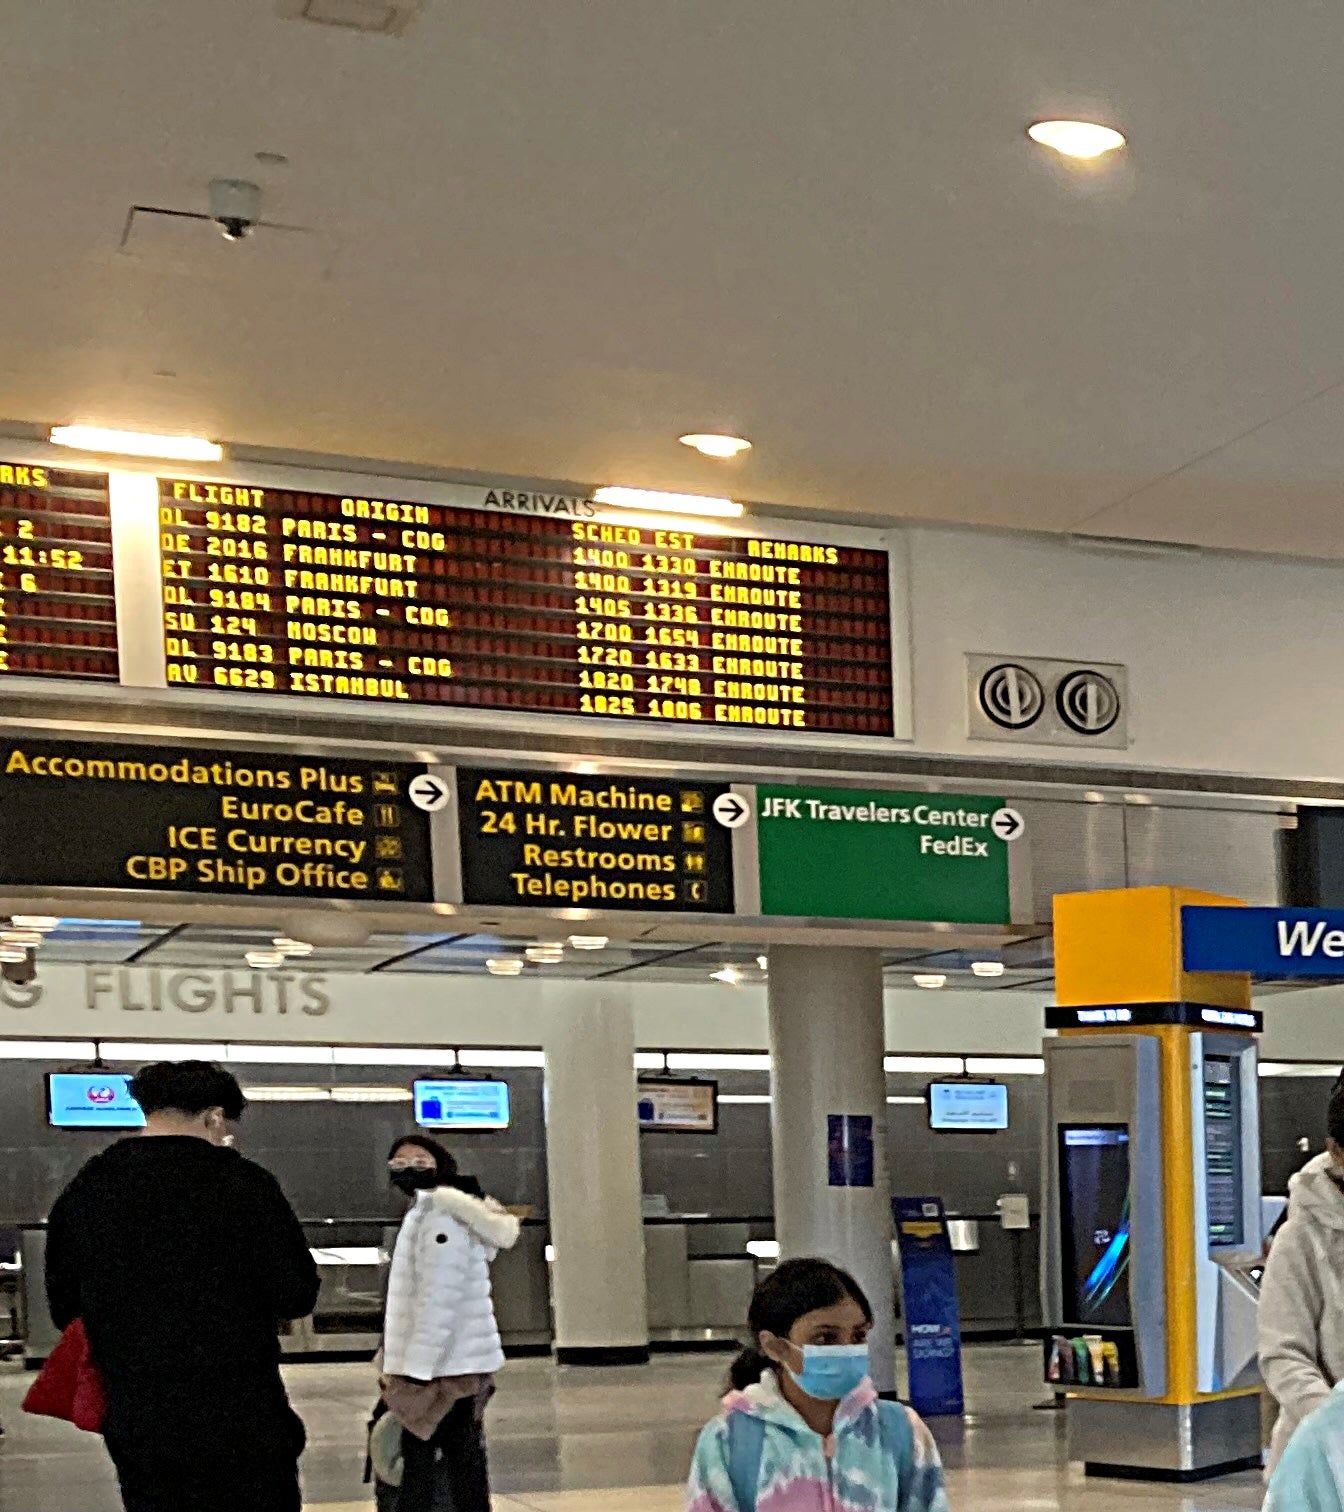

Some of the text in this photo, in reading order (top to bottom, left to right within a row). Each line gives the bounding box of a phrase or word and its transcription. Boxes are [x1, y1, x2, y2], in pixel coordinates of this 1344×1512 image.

[484, 490, 595, 518] ARRIVALS
[174, 482, 264, 508] FLIGHT
[341, 499, 429, 524] ORIGIN
[655, 531, 694, 550] EST
[747, 539, 838, 565] REMARKS
[3, 545, 83, 570] 11:52
[206, 511, 267, 534] 9182
[282, 518, 357, 542] PARIS
[402, 530, 445, 551] CDG
[574, 547, 629, 569] 1400
[642, 553, 696, 575] 1330
[710, 560, 800, 585] ENROUTE
[207, 537, 268, 560] 2016
[284, 543, 417, 573] FRANKFURT
[575, 571, 629, 593] 1400
[644, 578, 697, 600] 1319
[711, 584, 801, 609] ENROUTE
[162, 559, 191, 578] ET
[285, 569, 418, 598] FRANKFURT
[576, 596, 630, 617] 1405
[711, 608, 802, 632] ENROUTE
[209, 588, 270, 611] 9184
[286, 596, 360, 619] PARIS
[405, 606, 449, 627] CDG
[577, 621, 632, 642] 1700
[712, 632, 803, 656] ENROUTE
[211, 615, 257, 636] 124
[287, 621, 377, 645] MOSCOW
[577, 646, 632, 666] 1720
[713, 656, 803, 680] ENROUTE
[212, 641, 273, 663] 9183
[289, 647, 363, 670] PARIS
[408, 657, 452, 677] CDG
[714, 680, 805, 703] ENROUTE
[290, 672, 409, 699] ISTANBUL
[715, 704, 806, 727] ENROUTE
[6, 750, 363, 794] Accommodations Plus
[222, 796, 364, 826] EuroCafe
[475, 779, 672, 812] ATM Machine
[762, 797, 989, 829] JFK Travelers Center
[168, 826, 366, 863] ICE Currency
[480, 811, 671, 842] 24 Hr. Flower
[523, 844, 675, 871] Restrooms
[920, 834, 988, 858] FedEx
[126, 854, 367, 890] CBP Ship Office
[510, 872, 675, 902] Telephones
[84, 965, 331, 1017] FLIGHTS
